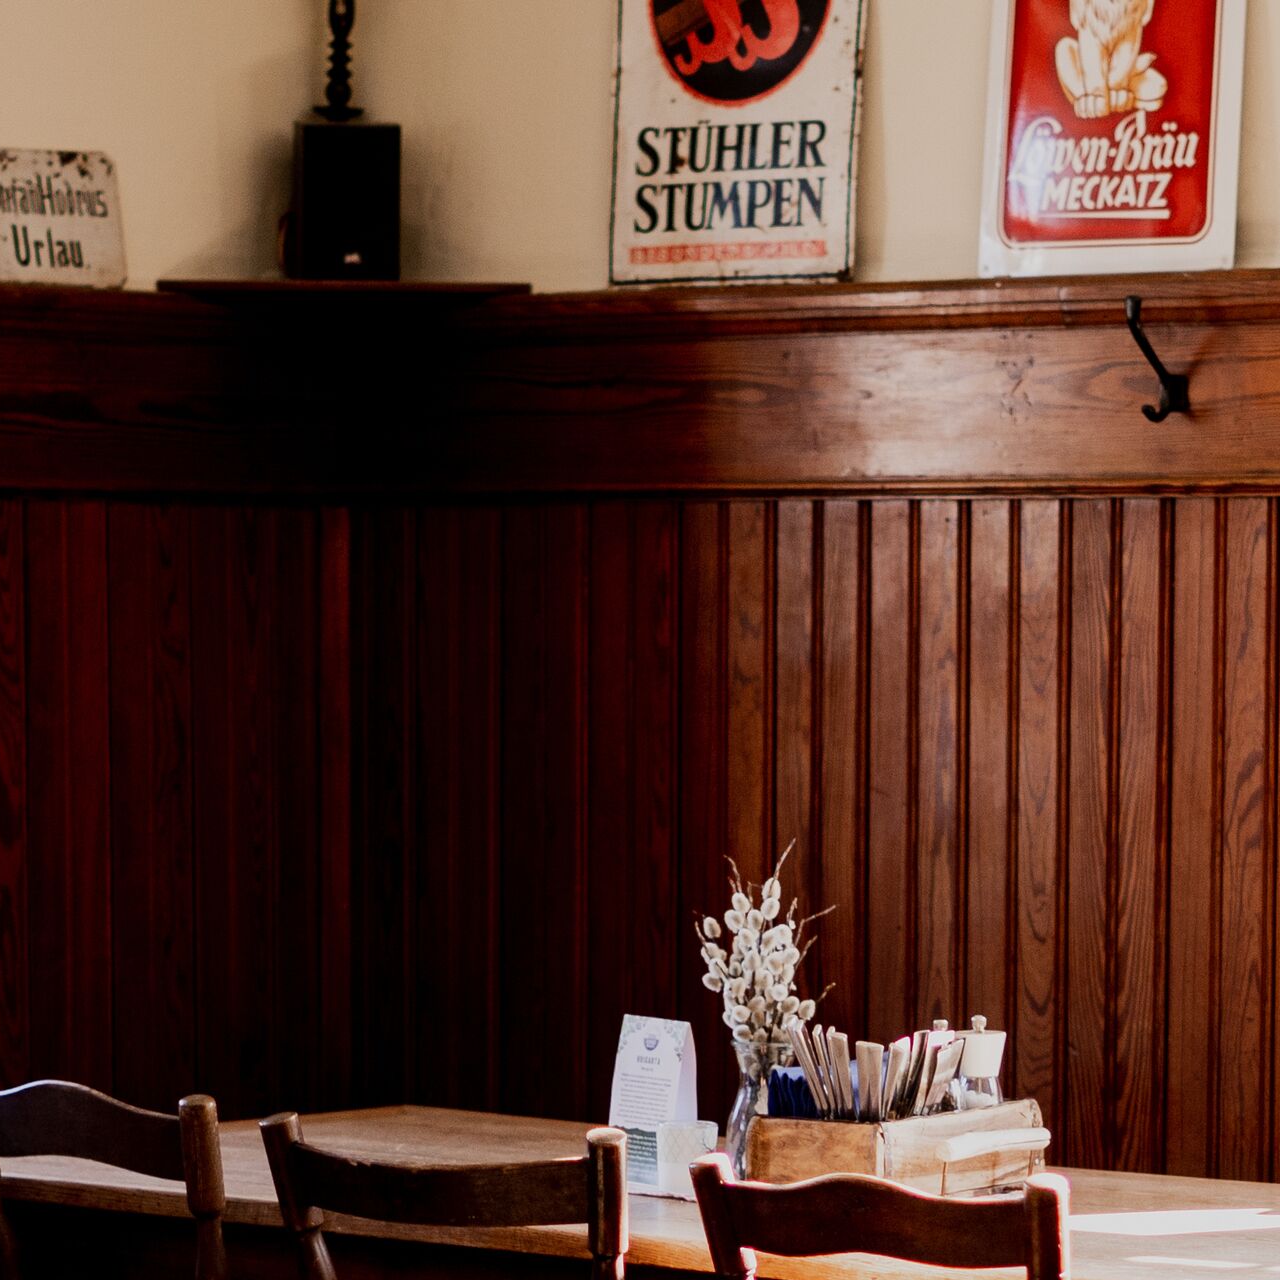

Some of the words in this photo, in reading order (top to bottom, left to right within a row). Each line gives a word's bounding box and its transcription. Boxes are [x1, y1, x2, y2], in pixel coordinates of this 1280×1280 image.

[635, 119, 827, 177] STÜHLER
[634, 177, 826, 233] STUMPEN
[1039, 172, 1173, 211] MECKATZ
[11, 223, 84, 268] Urlau
